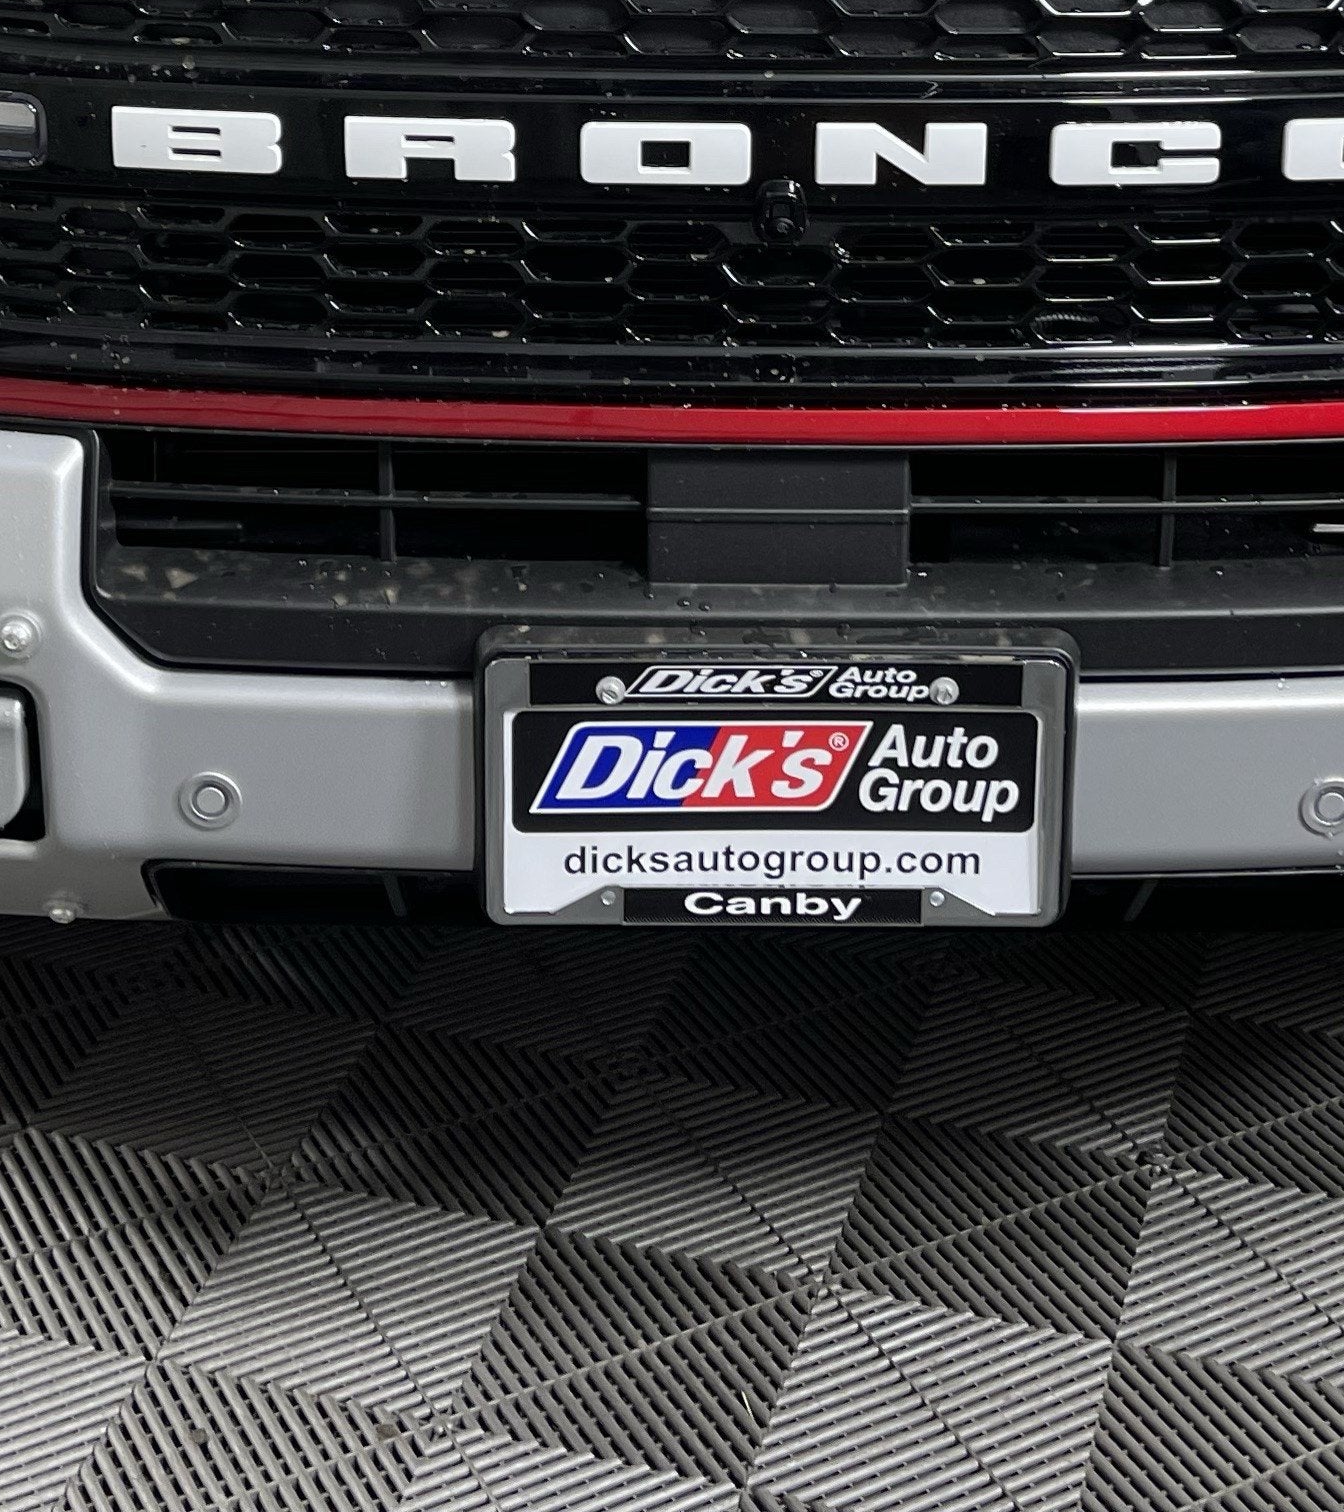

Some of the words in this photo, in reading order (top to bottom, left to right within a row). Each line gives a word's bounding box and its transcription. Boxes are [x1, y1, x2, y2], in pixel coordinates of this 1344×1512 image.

[639, 669, 814, 694] Dick's
[836, 666, 918, 684] Auto
[828, 681, 930, 702] Group
[868, 724, 999, 769] Auto
[858, 769, 1019, 822] Group
[564, 845, 981, 880] dicksautogroup.com
[684, 892, 862, 921] Canby
